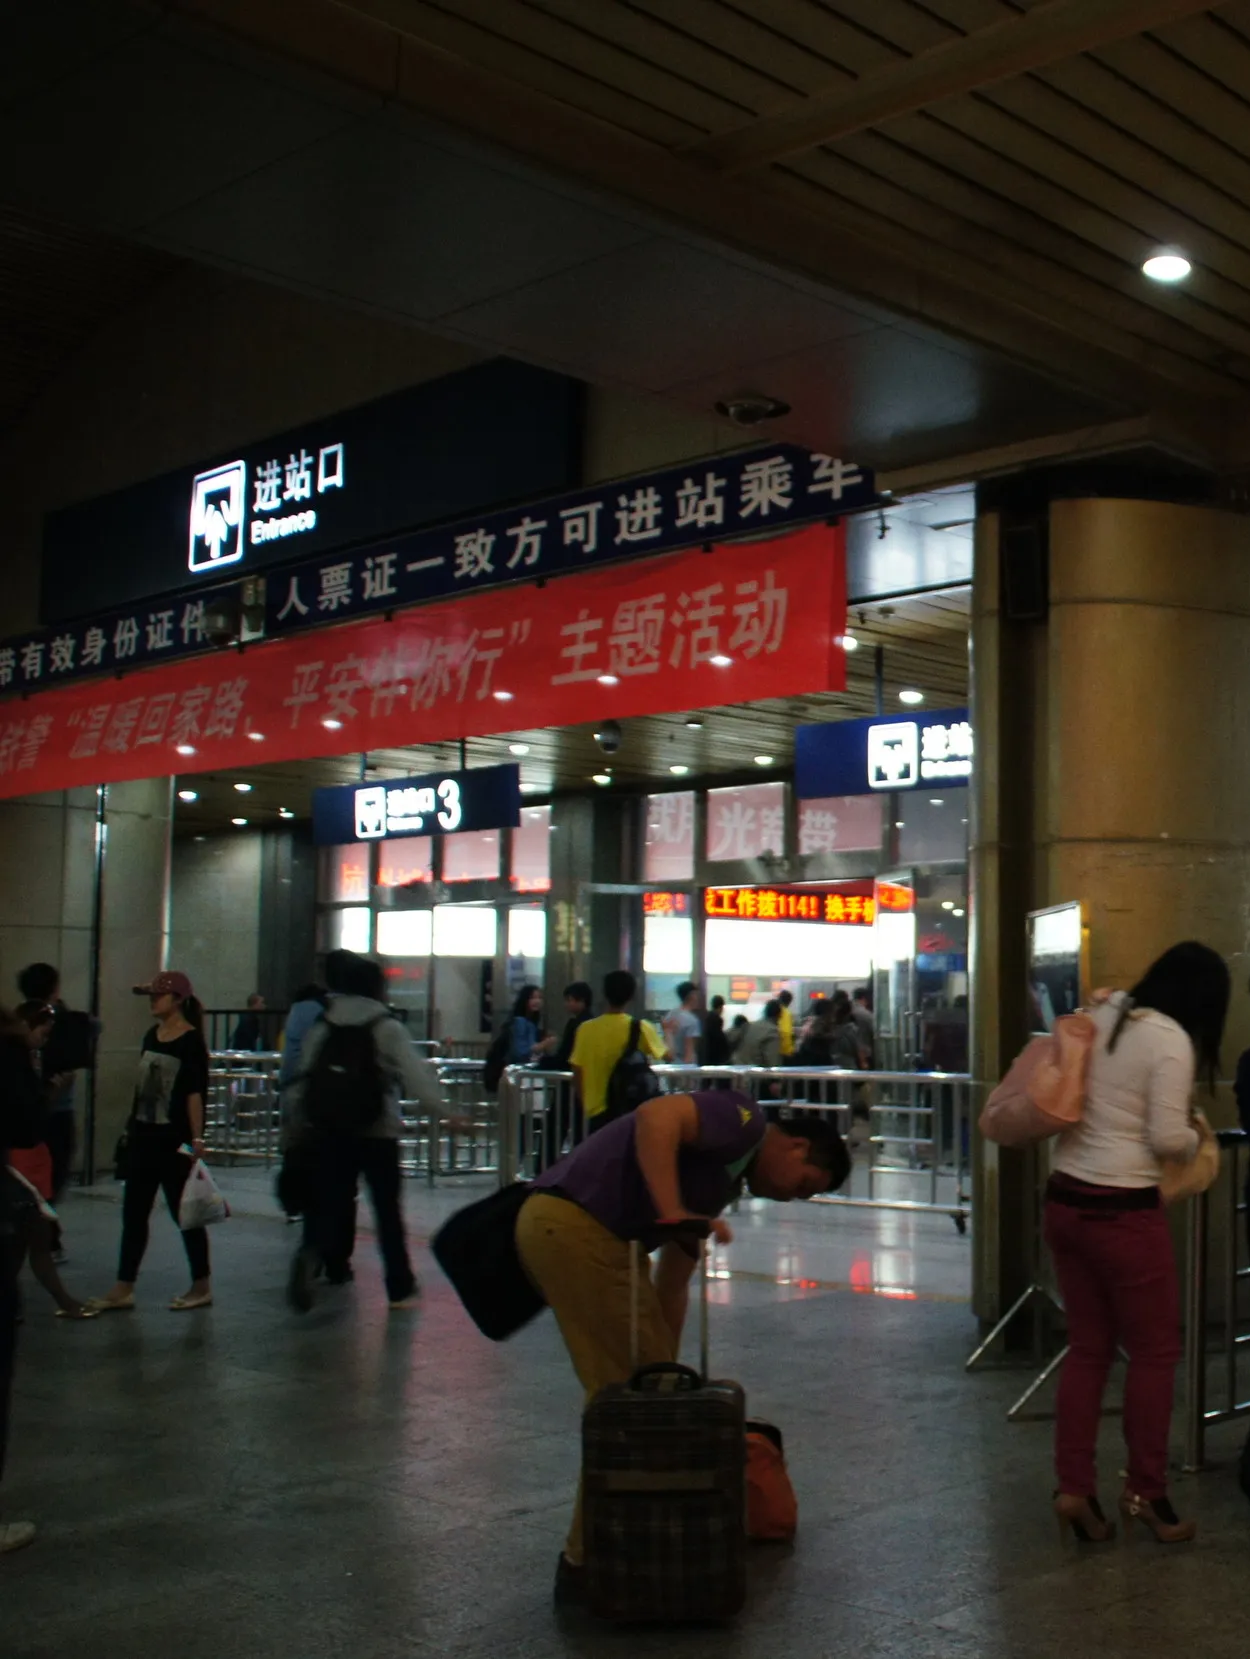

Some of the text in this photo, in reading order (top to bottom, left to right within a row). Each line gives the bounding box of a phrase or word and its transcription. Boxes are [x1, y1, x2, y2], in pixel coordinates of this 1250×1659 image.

[252, 442, 344, 512] 进站口
[250, 509, 317, 544] Entrance
[436, 778, 462, 830] 3
